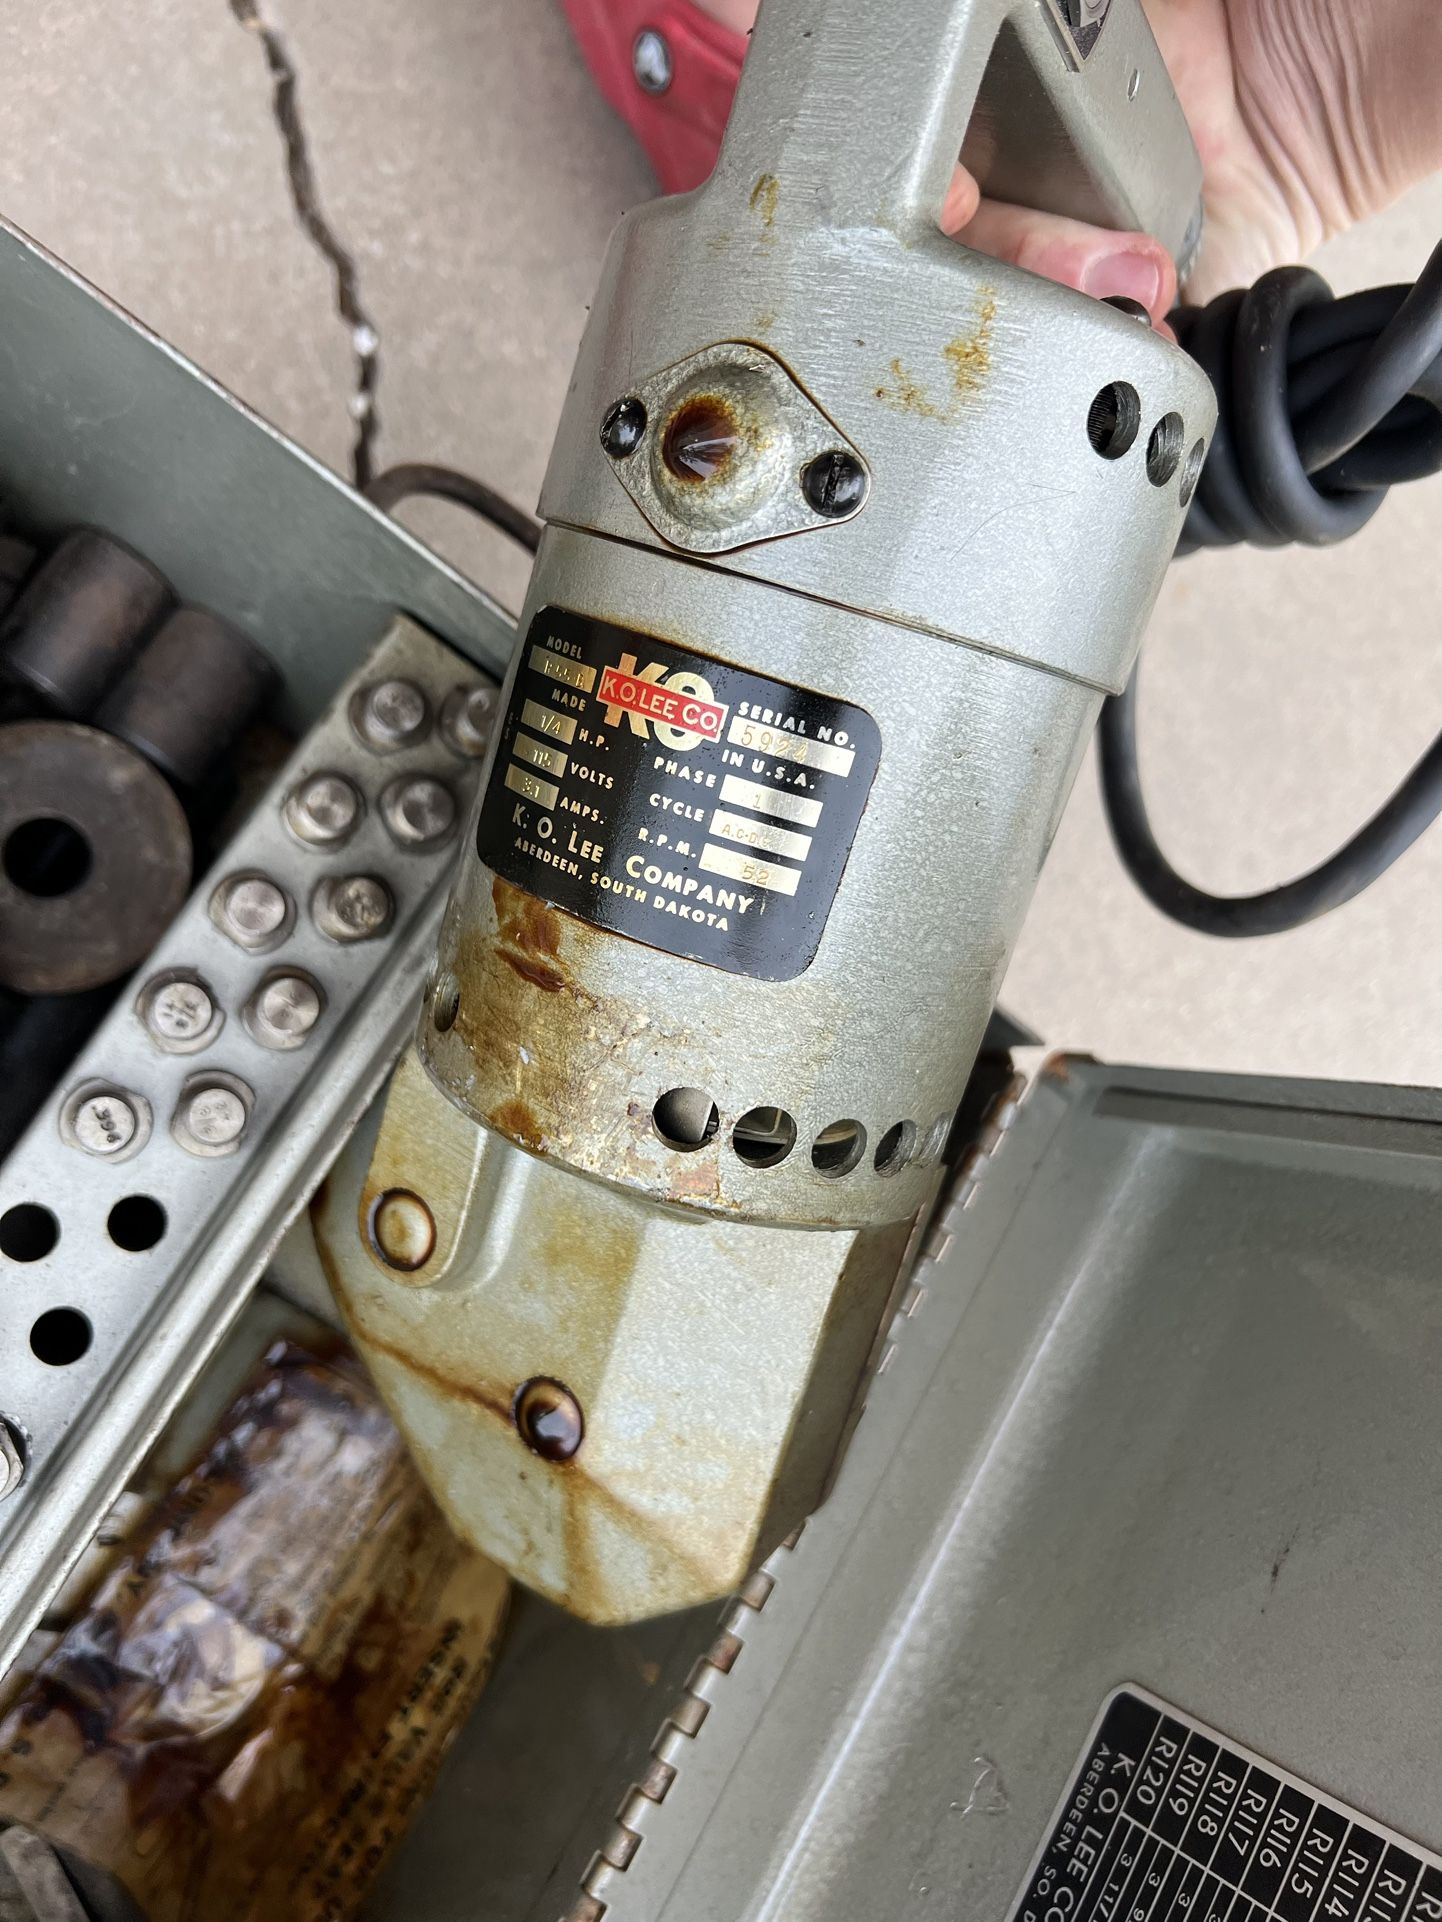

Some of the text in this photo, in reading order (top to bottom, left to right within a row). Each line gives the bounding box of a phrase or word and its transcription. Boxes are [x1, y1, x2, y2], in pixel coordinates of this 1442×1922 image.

[546, 635, 583, 660] MODEL
[551, 688, 815, 790] MADE IN U.S.A.
[578, 728, 610, 751] H.P.
[682, 703, 718, 733] CO.
[738, 701, 856, 750] SERIAL NO.
[571, 762, 614, 790] VOLTS
[653, 756, 717, 789] PHASE
[560, 796, 605, 825] AMPS.
[649, 793, 705, 823] CYCLE
[537, 816, 558, 845] O.
[567, 830, 605, 865] LEE
[625, 855, 755, 915] COMPANY
[637, 827, 697, 859] R.P.M.
[514, 836, 730, 932] ABERDEEN, SOUTH DAKOTA
[1136, 1736, 1178, 1805] R120
[1168, 1754, 1207, 1816] R119
[1051, 1742, 1111, 1853] ABERDEEN,
[1093, 1787, 1120, 1813] O.
[1197, 1771, 1238, 1836] R118
[1228, 1789, 1268, 1856] R117
[1258, 1808, 1300, 1868] R116
[1066, 1825, 1104, 1882] LEE
[1120, 1853, 1133, 1867] 3
[1290, 1828, 1335, 1899] R115
[1148, 1872, 1161, 1887] 3
[1178, 1892, 1191, 1908] 3
[1361, 1869, 1407, 1922] R11
